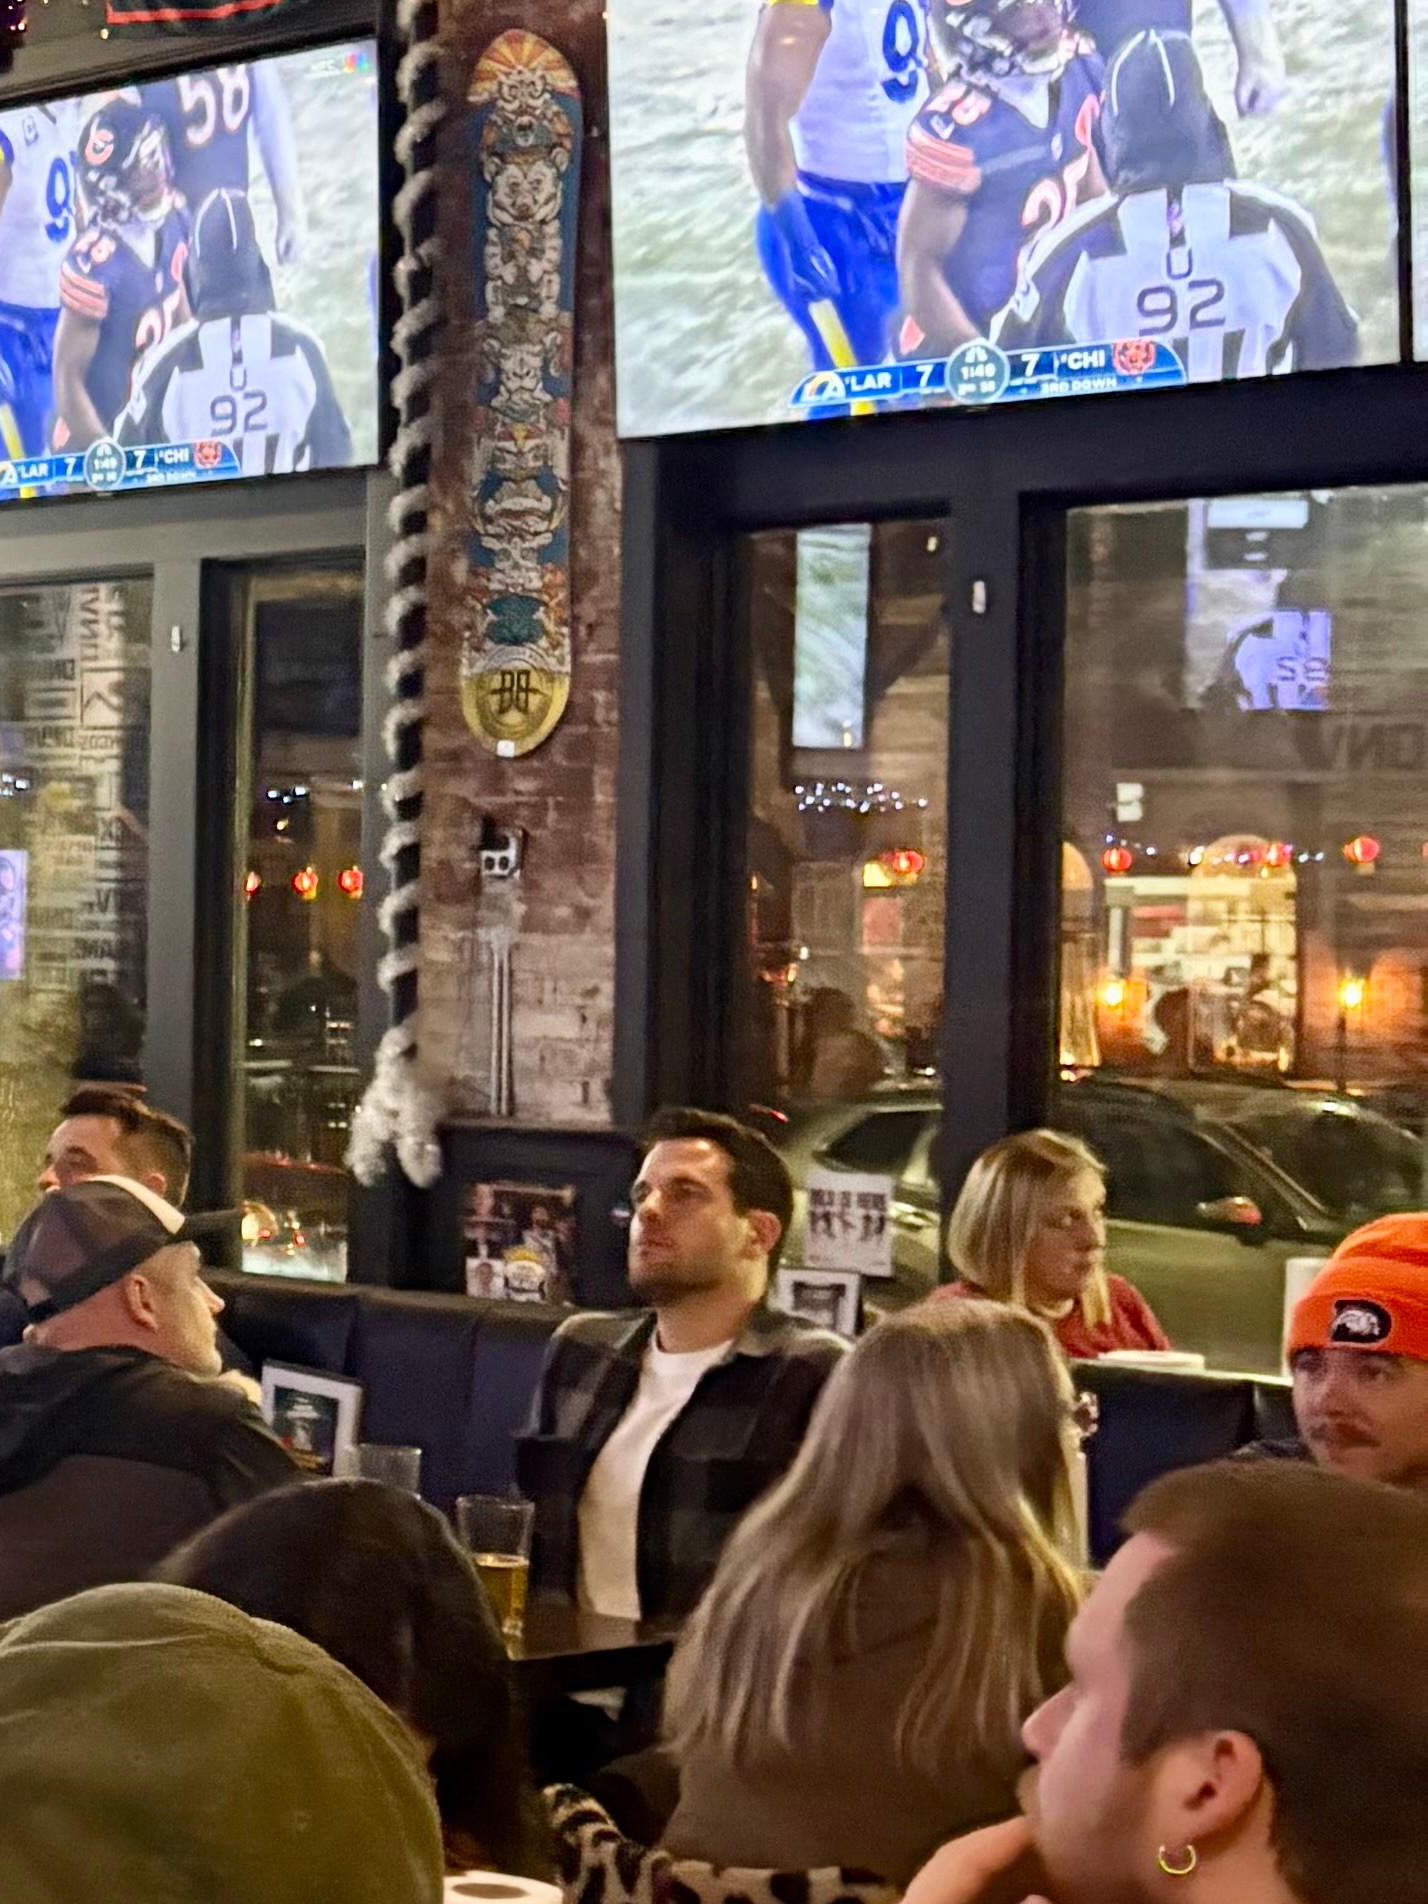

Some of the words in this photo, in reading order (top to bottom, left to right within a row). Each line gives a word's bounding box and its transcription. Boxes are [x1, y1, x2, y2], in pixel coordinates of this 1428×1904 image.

[181, 62, 251, 147] 58
[1135, 277, 1226, 335] 92
[915, 365, 932, 387] 7
[1021, 354, 1038, 376] 7
[1071, 377, 1117, 391] DOWN
[210, 389, 269, 435] 92
[64, 458, 76, 475] 7
[134, 451, 145, 469] 7
